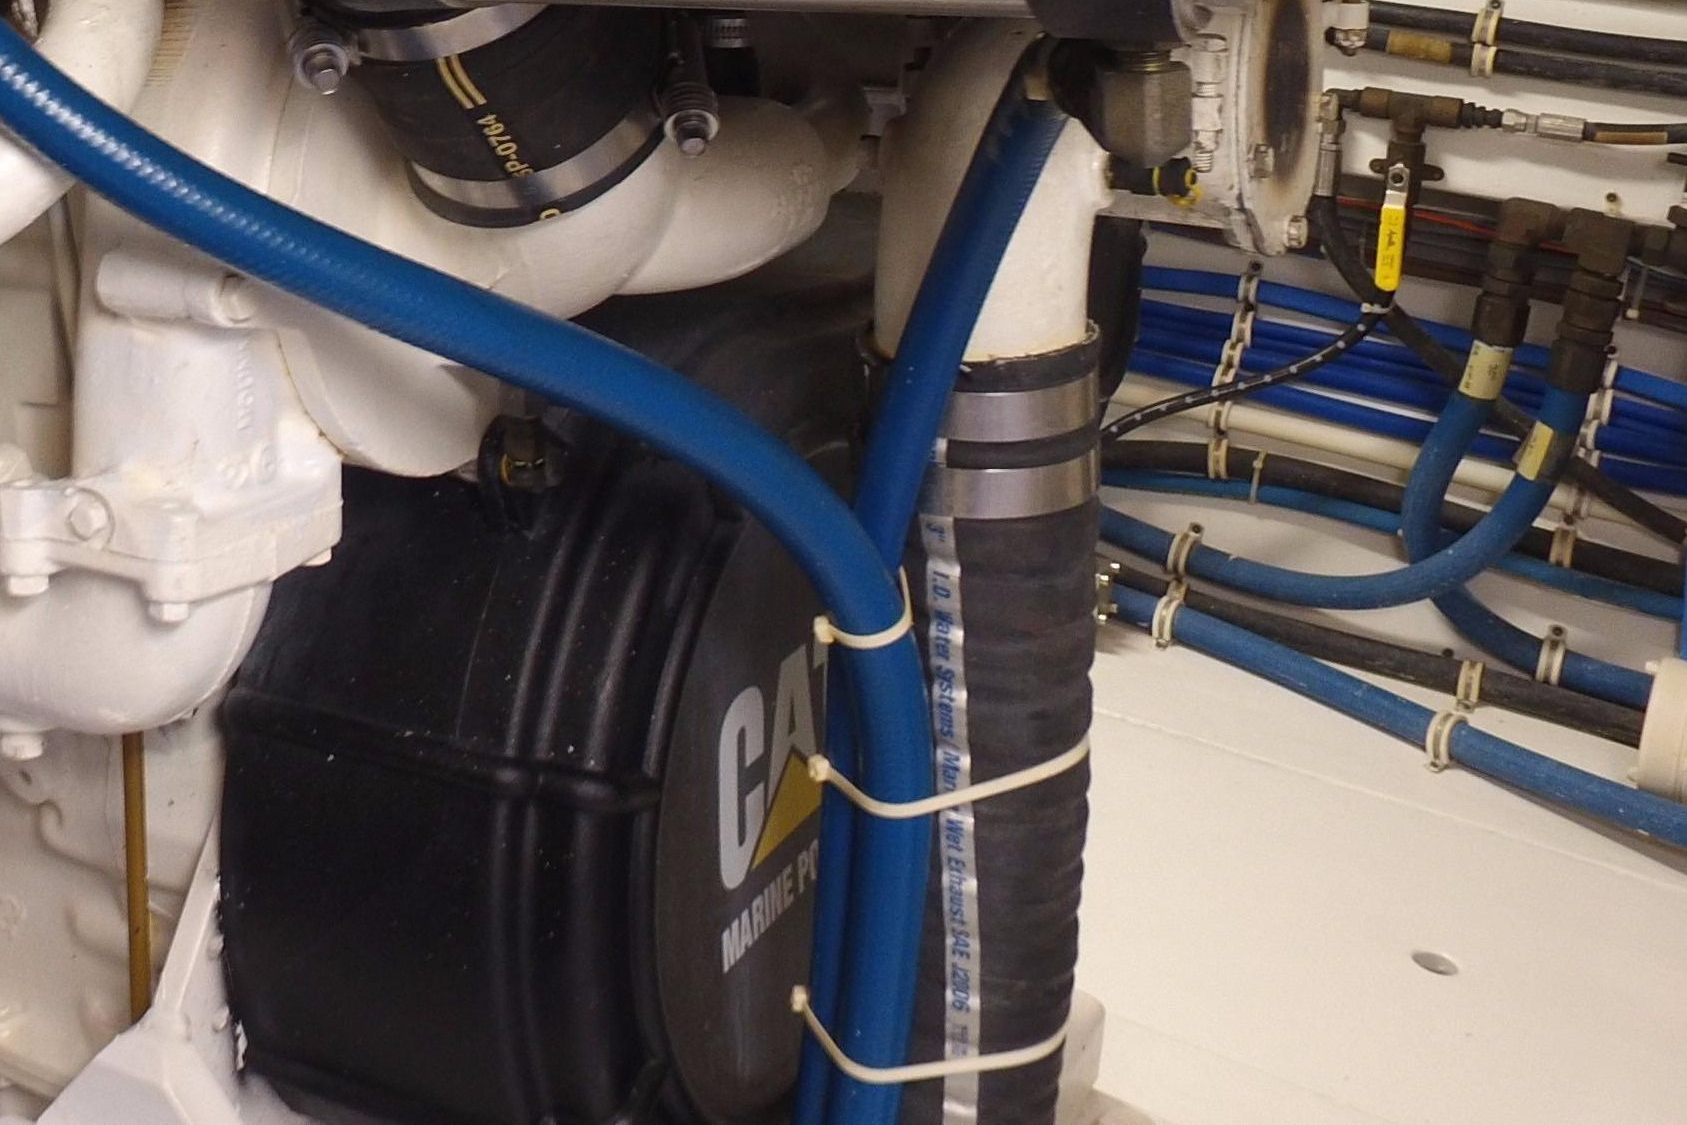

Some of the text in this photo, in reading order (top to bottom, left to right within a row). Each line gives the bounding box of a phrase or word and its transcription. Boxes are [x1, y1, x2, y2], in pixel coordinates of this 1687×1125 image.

[935, 612, 953, 661] Water
[936, 666, 956, 740] Systems
[945, 818, 965, 853] Wet
[722, 868, 795, 974] MARINE
